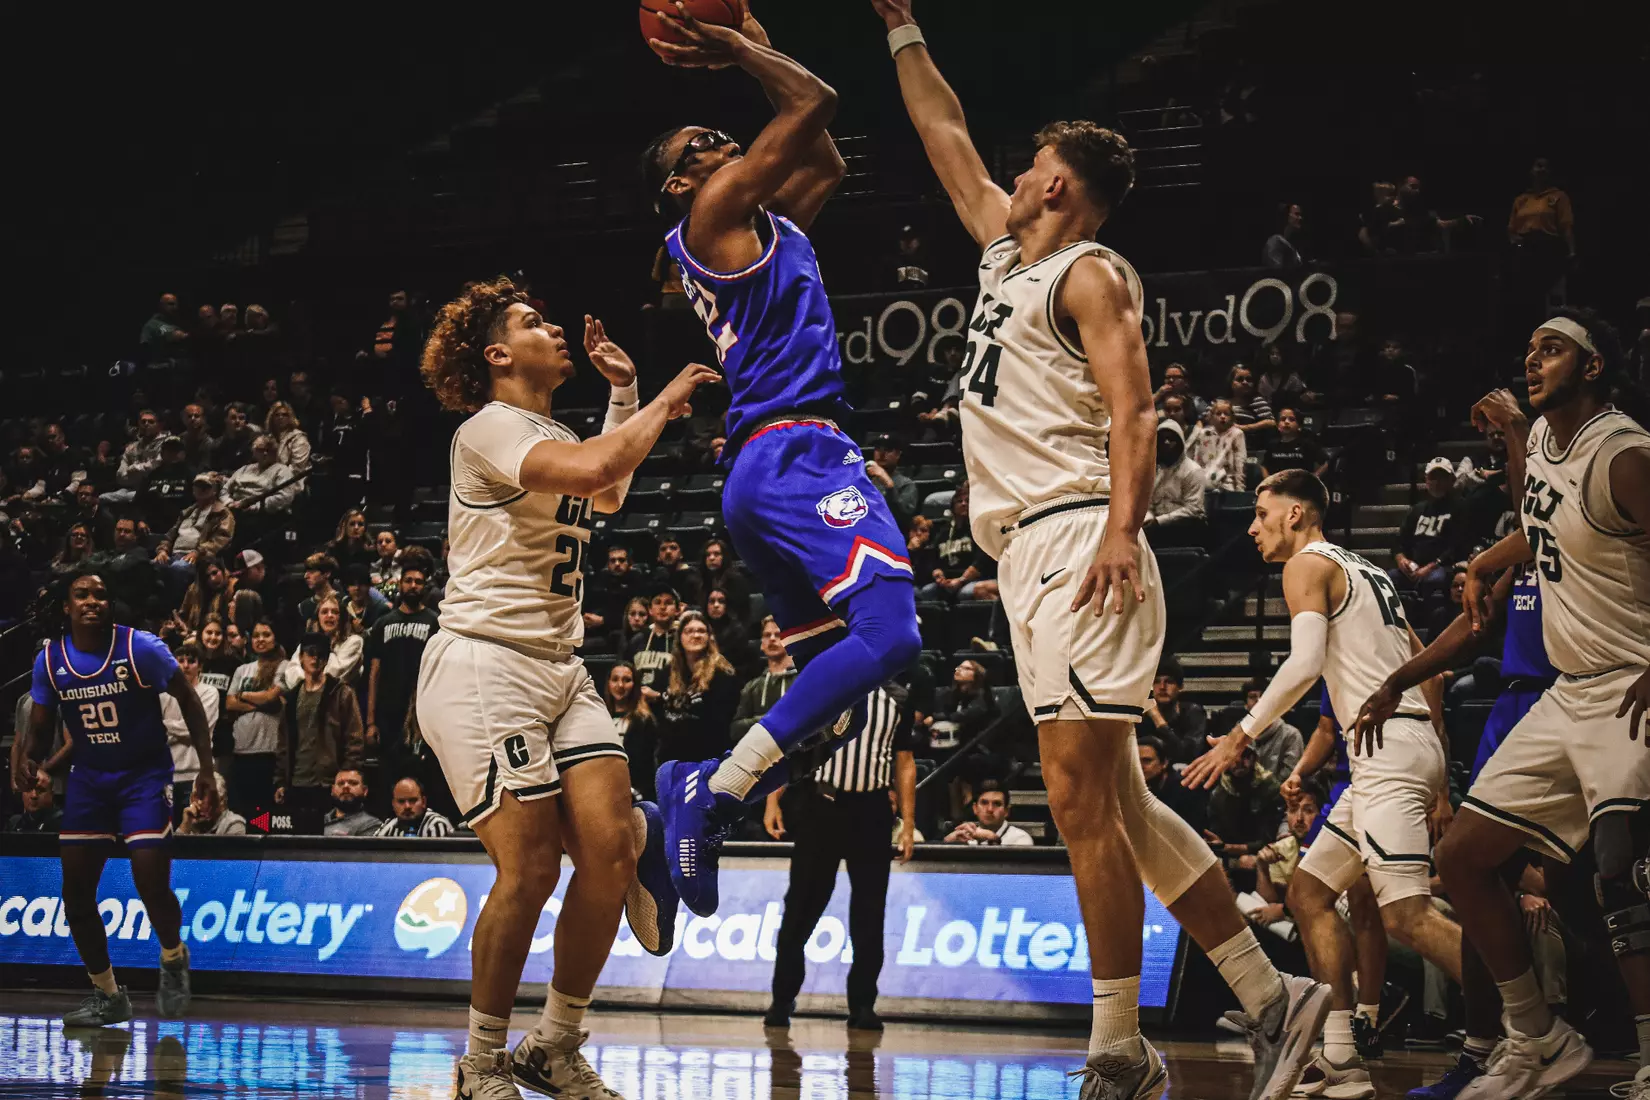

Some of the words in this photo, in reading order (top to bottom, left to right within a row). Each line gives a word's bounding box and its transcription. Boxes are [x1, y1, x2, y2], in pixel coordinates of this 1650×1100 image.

[836, 297, 967, 366] d98
[1143, 273, 1338, 348] lvd98
[549, 533, 584, 603] 2
[1358, 568, 1409, 631] 12
[58, 681, 129, 701] LOUISIANA
[78, 700, 120, 730] 20
[86, 731, 122, 745] TECH
[271, 815, 293, 829] POSS.
